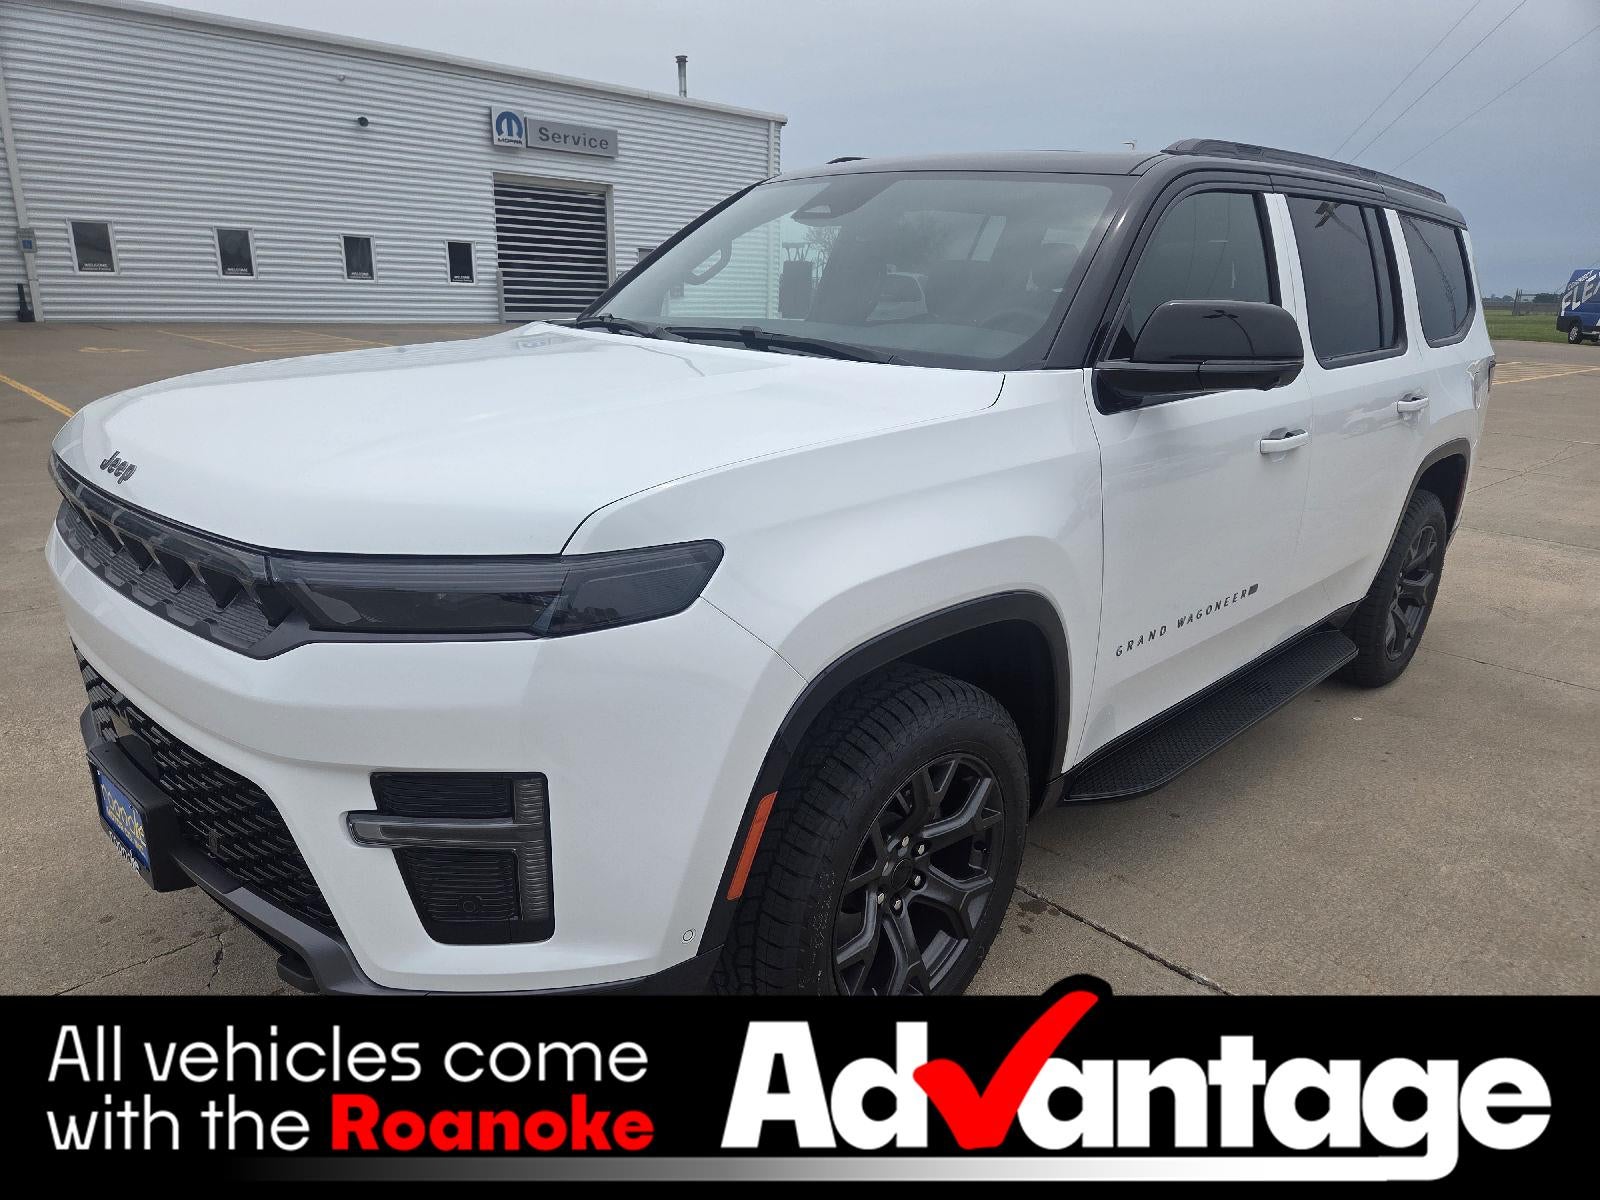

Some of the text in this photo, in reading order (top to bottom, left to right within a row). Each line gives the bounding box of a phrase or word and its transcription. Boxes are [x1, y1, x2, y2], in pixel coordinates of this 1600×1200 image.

[497, 137, 523, 145] MOPAR
[538, 126, 609, 150] Service
[100, 450, 137, 484] Jeep
[1115, 588, 1247, 657] GRAND WAGONEER
